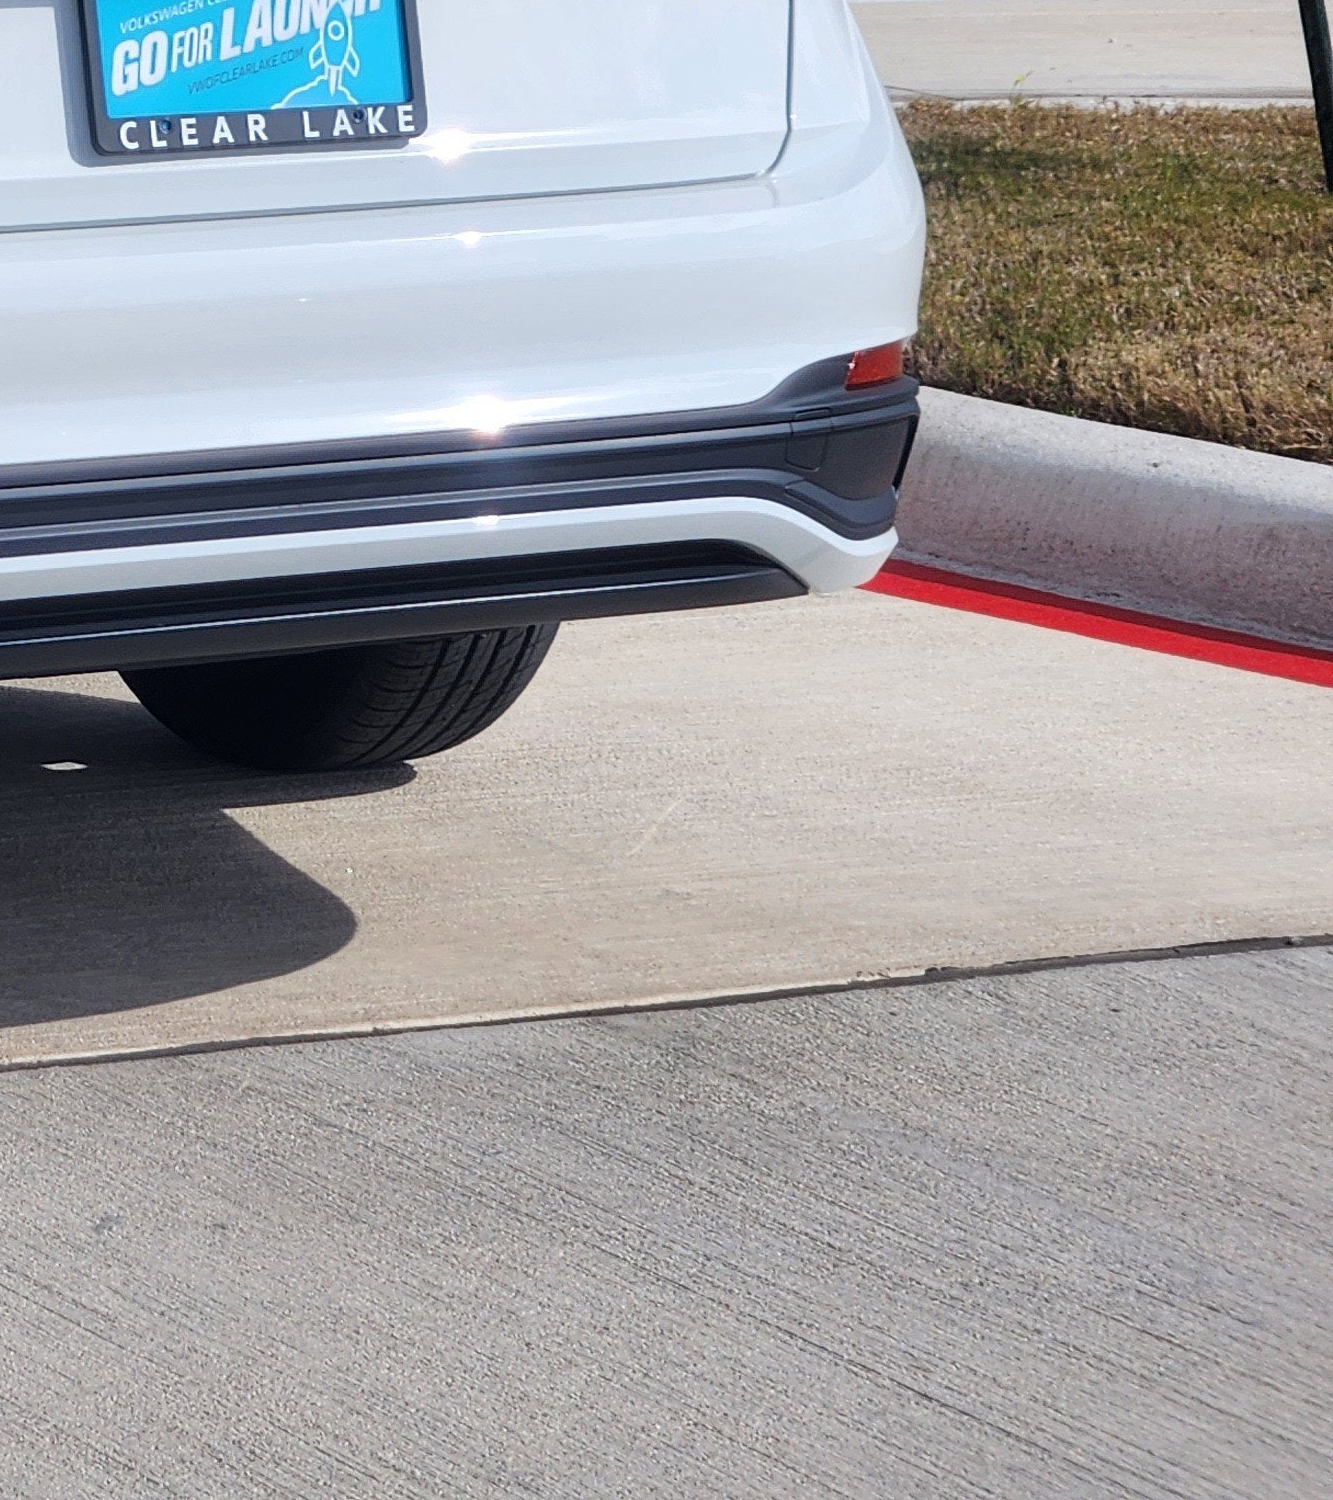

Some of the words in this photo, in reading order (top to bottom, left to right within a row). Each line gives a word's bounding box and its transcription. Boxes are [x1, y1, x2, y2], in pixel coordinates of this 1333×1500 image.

[111, 29, 169, 97] GO
[170, 20, 214, 73] FOR
[119, 113, 269, 151] CLEAR
[301, 104, 416, 139] LAKE
